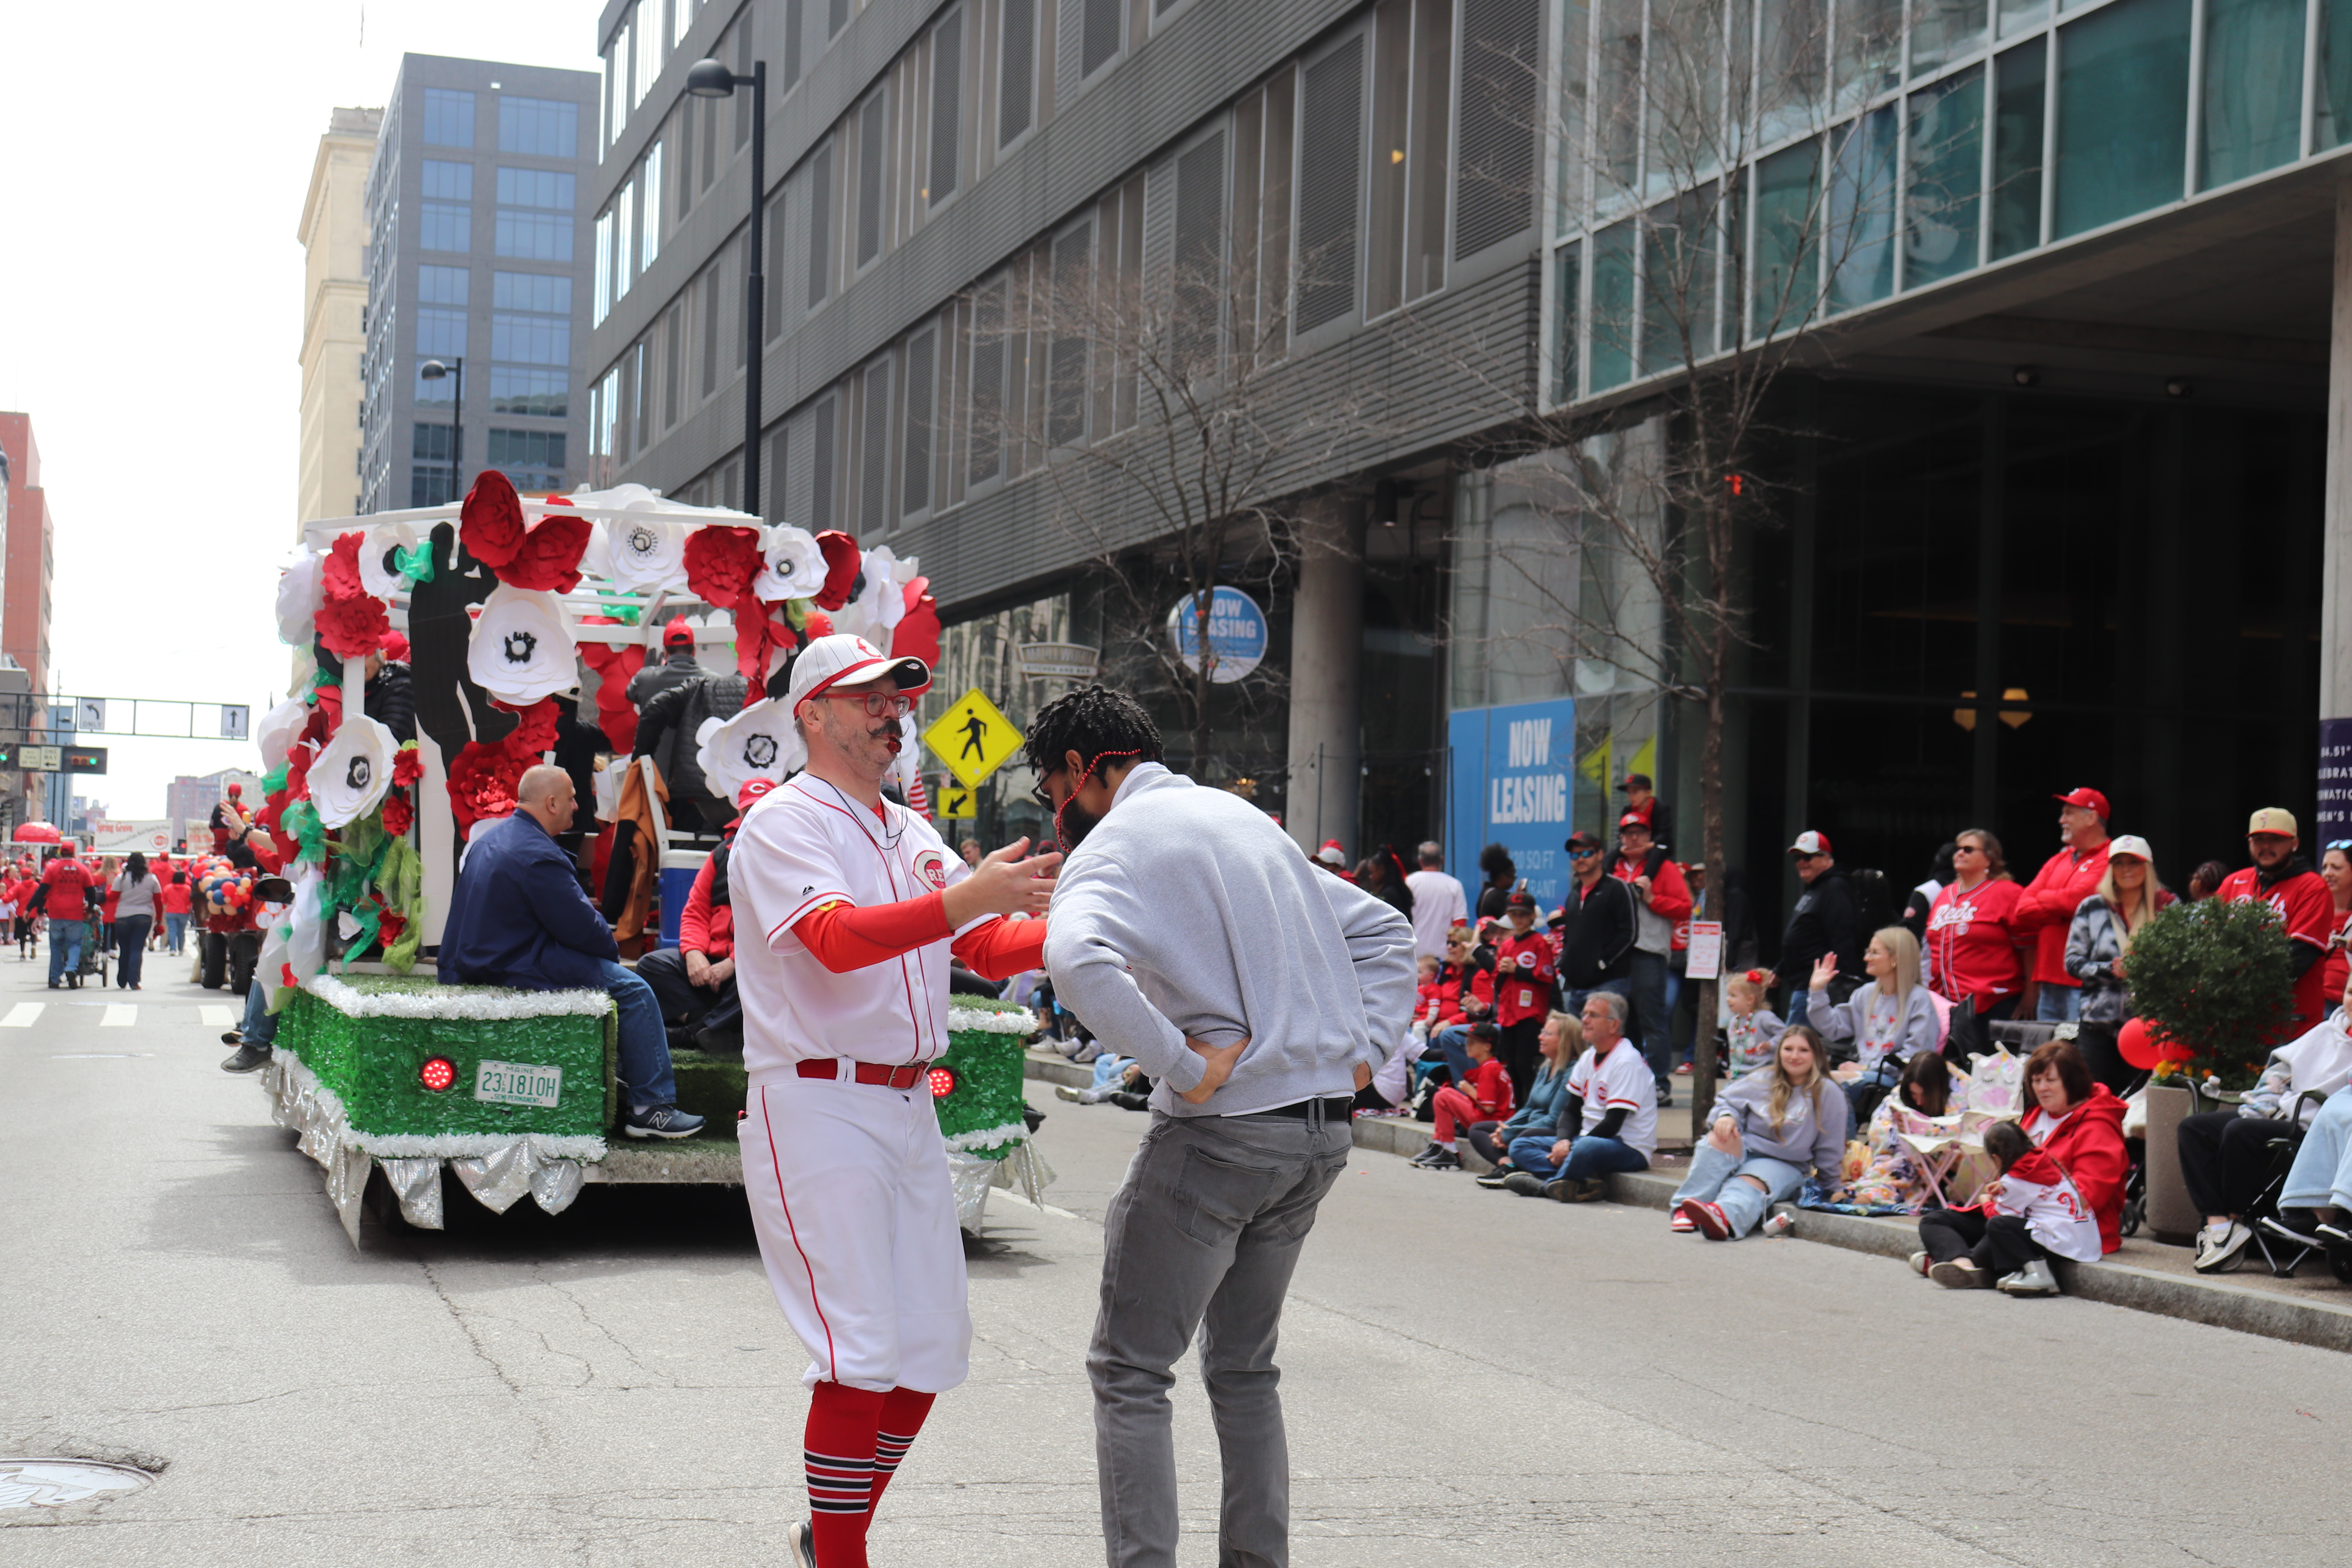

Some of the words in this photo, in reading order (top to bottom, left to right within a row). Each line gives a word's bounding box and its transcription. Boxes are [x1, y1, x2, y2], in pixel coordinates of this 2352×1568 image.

[1187, 617, 1257, 639] LASING
[1508, 718, 1552, 768] NOW
[748, 782, 766, 794] C
[1491, 773, 1566, 824] LEASING
[96, 820, 114, 833] Spring
[115, 822, 133, 833] Grove
[1928, 900, 1978, 931] Reds
[506, 1066, 535, 1074] MAINE
[482, 1072, 502, 1092] 23
[508, 1095, 540, 1104] PERMANENT
